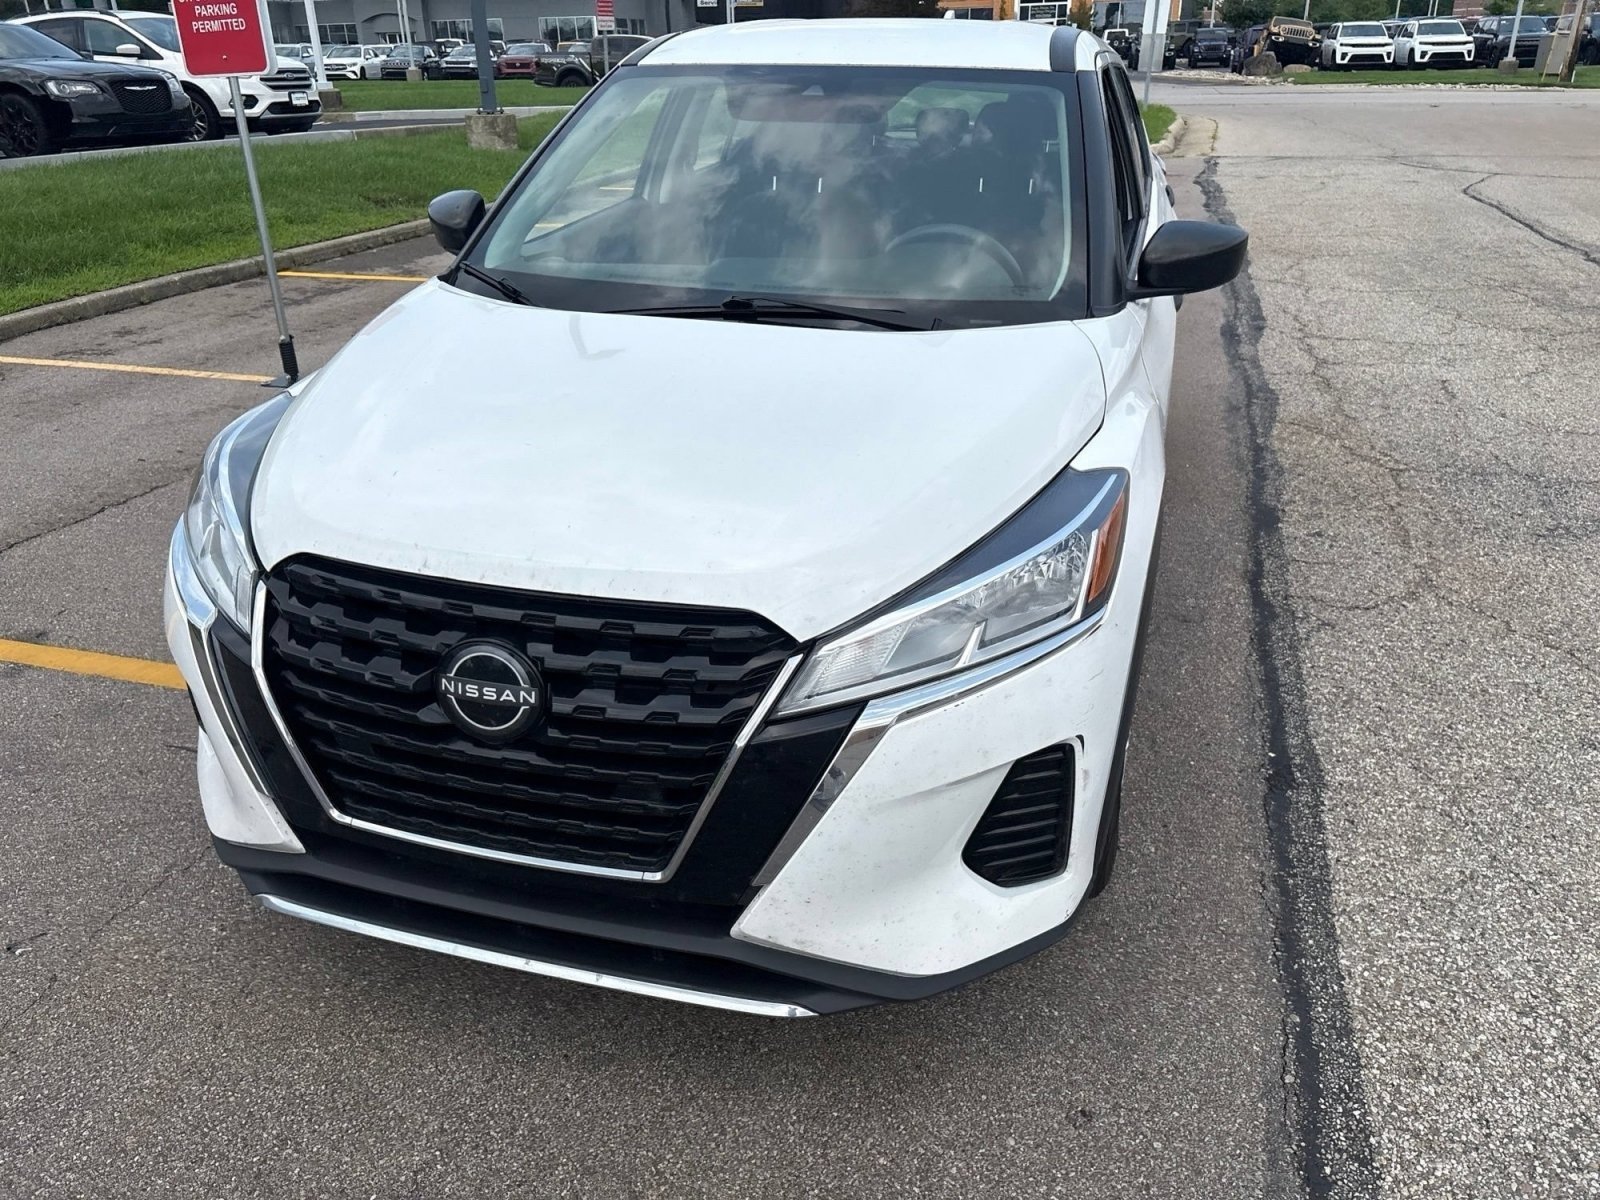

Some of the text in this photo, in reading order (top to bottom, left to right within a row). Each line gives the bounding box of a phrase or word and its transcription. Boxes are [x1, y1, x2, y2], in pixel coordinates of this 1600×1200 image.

[194, 3, 238, 17] PARKING
[192, 18, 246, 33] PERMITTED
[441, 678, 536, 703] NISSAN
